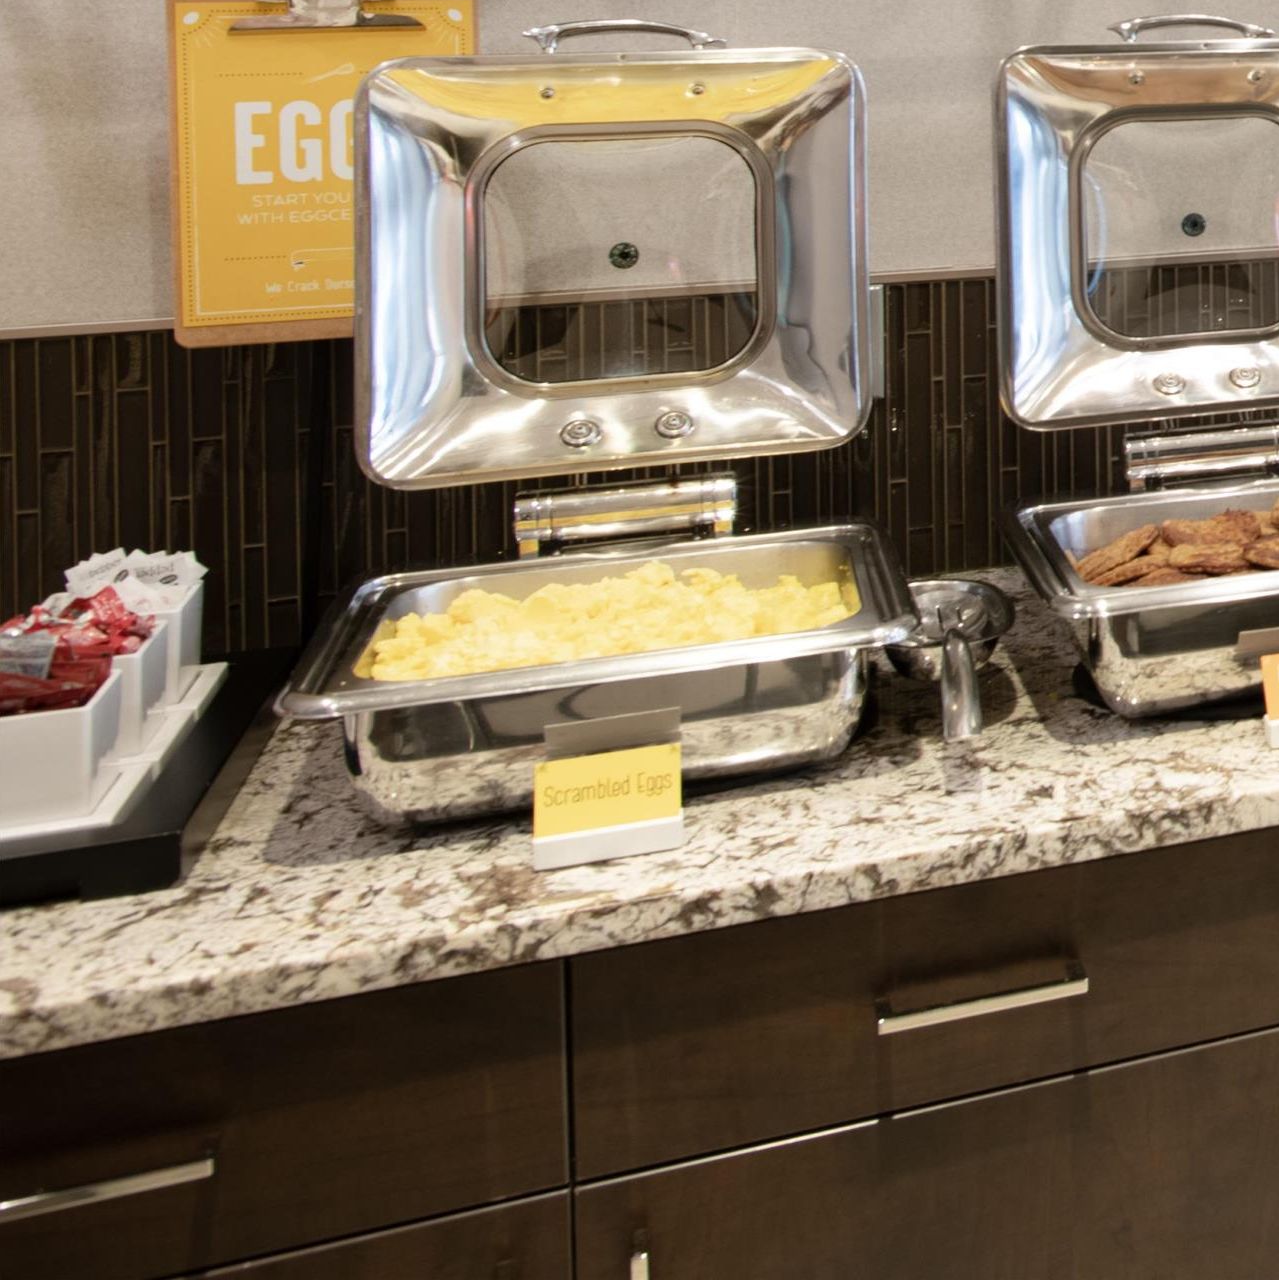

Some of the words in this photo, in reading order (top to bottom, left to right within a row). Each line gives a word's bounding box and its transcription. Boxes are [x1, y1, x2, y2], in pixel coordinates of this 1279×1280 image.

[252, 193, 308, 208] START
[237, 209, 285, 225] WITH
[543, 774, 630, 808] Scrambled
[636, 771, 673, 797] Eggs
